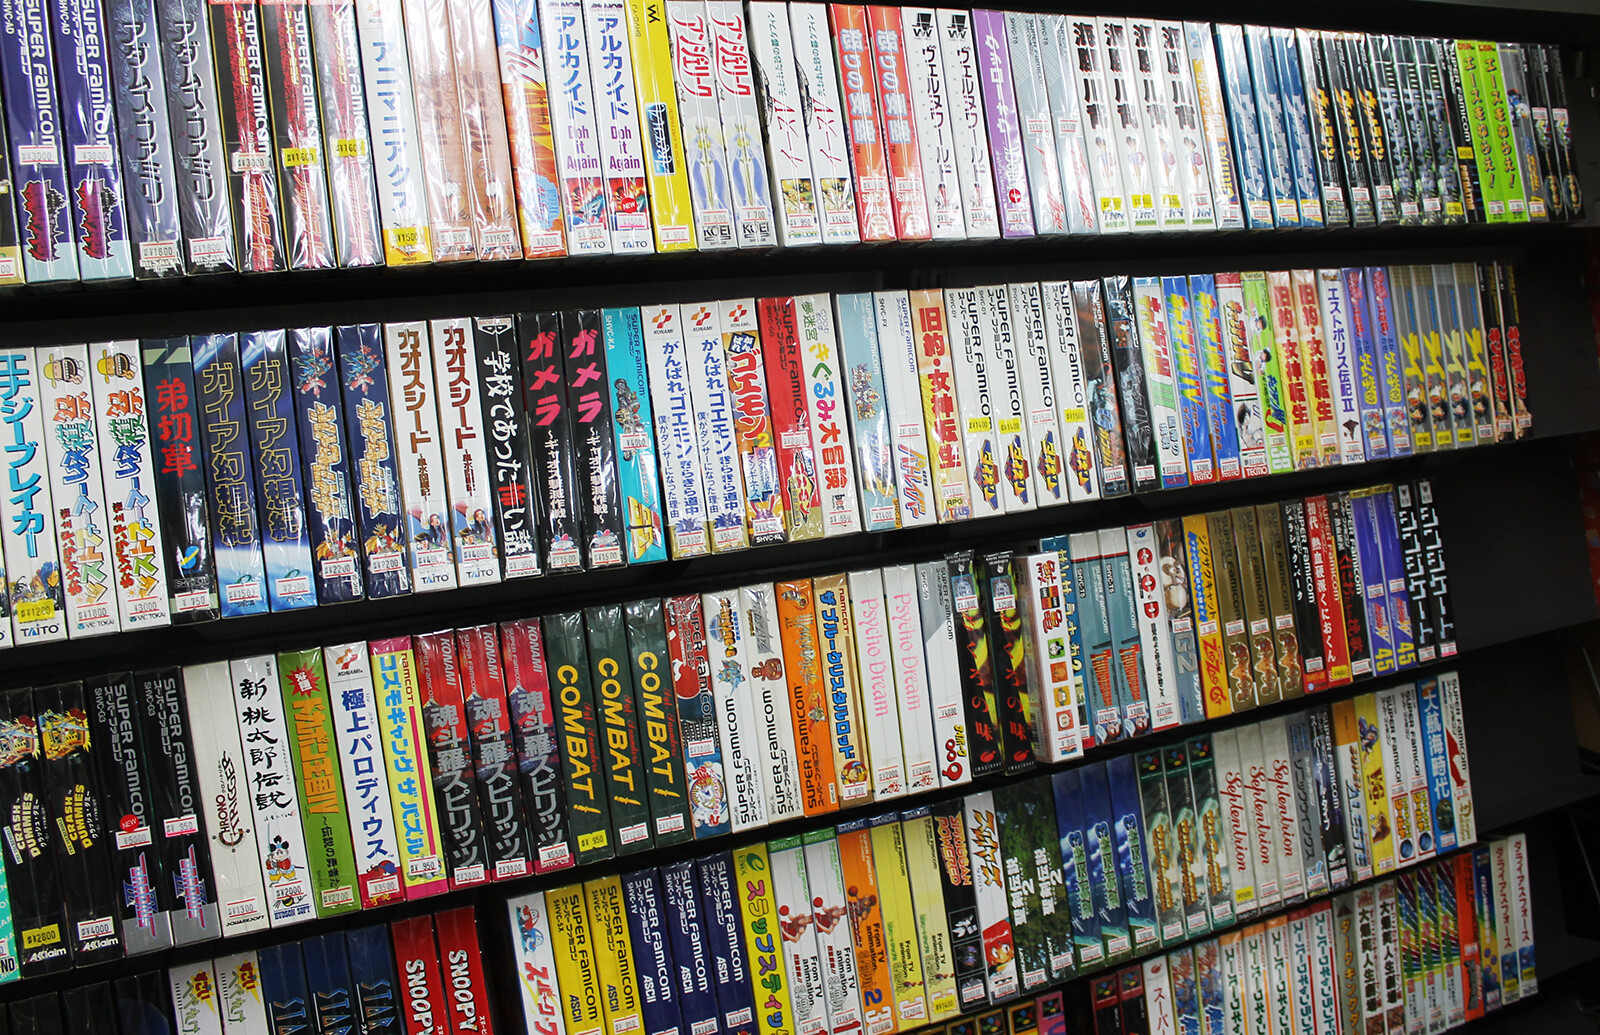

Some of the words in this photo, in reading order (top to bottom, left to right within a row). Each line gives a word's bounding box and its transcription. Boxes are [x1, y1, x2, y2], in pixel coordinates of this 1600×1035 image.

[554, 16, 587, 120] アルカノイド
[598, 17, 630, 120] アルカノイド
[840, 28, 876, 144] 怒りの要塞
[876, 29, 911, 144] 怒りの要塞
[1073, 22, 1101, 130] 海腹川背
[1104, 22, 1139, 130] 海腹川背
[567, 155, 598, 170] Again
[610, 156, 640, 170] Again
[623, 200, 637, 210] NEW
[704, 225, 730, 236] KOEI
[743, 224, 770, 236] KOEI
[605, 314, 615, 350] SHVC-KA
[631, 314, 640, 352] SUPER
[780, 304, 795, 362] SUPER
[900, 297, 910, 325] SUPER
[905, 326, 915, 373] Famicom
[966, 291, 981, 346] SUPER
[995, 289, 1010, 343] SUPER
[1028, 286, 1043, 340] SUPER
[1059, 284, 1073, 337] SUPER
[526, 331, 561, 426] ガメラ
[569, 329, 603, 424] ガメラ
[635, 353, 647, 396] Famicom
[1274, 286, 1309, 425] 旧約・女神転生
[1298, 284, 1334, 422] 旧約・女神転生
[1327, 288, 1354, 413] エストポリス伝記II
[398, 329, 431, 453] カオスシード
[444, 328, 477, 450] カオスシード
[730, 347, 768, 439] ゴエモン
[809, 342, 848, 490] きぐるみ大冒険
[918, 306, 961, 469] 旧約・女神転生
[0, 354, 45, 558] エナジーブレイカー
[156, 379, 198, 478] 弟切草
[202, 362, 252, 546] ガイア幻想紀
[251, 359, 302, 542] ガイア幻想紀
[483, 350, 533, 554] 学校であった怖い話
[662, 341, 691, 459] がんばれゴエモン
[680, 459, 700, 515] きらきら道中
[701, 338, 732, 456] がんばれゴエモン
[720, 455, 740, 511] きらきら道中
[657, 414, 680, 519] 僕がダンサーになった理由
[697, 410, 720, 513] 僕がダンサーになった理由
[1303, 546, 1316, 603] Famicom
[527, 625, 542, 672] KONAMI
[945, 604, 954, 640] Famicom
[440, 638, 456, 686] KONAMI
[483, 631, 499, 679] KONAMI
[902, 655, 921, 711] Dream
[113, 683, 133, 744] SUPER
[163, 677, 183, 738] SUPER
[695, 660, 713, 728] Famicom
[793, 686, 809, 753] Famicom
[870, 661, 889, 718] Dream
[240, 677, 293, 811] 新桃太郎伝説
[725, 698, 743, 765] Famicom
[762, 690, 779, 755] Famicom
[341, 688, 388, 859] 極上パロディウス
[379, 656, 415, 780] コズモギャング
[400, 800, 424, 854] パズル
[431, 703, 479, 868] 魂斗羅スピリッツ
[474, 696, 521, 859] 魂斗羅スピリッツ
[517, 690, 563, 846] 魂斗羅スピリッツ
[803, 758, 819, 810] SUPER
[65, 796, 78, 841] CRASH
[74, 784, 93, 849] DUMMIES
[735, 773, 750, 824] SUPER
[772, 765, 787, 815] SUPER
[872, 814, 897, 826] BANDAI
[12, 804, 26, 850] CRASH
[22, 792, 41, 858] DUMMIES
[122, 817, 138, 829] NEW
[934, 816, 960, 887] POWERED
[950, 811, 973, 886] SPRIGGAN
[592, 890, 602, 922] SHVC-SX
[627, 882, 638, 914] SHVC-TV
[635, 881, 652, 944] スーパーファミコン
[665, 873, 676, 905] SHVC-TV
[672, 872, 690, 935] スーパーファミコン
[701, 865, 712, 897] SHVC-TV
[708, 863, 725, 926] スーパーファミコン
[274, 908, 295, 920] HUDSON
[296, 906, 311, 915] SOFT
[553, 899, 564, 932] SHVC-SX
[561, 897, 577, 962] スーパーファミコン
[600, 888, 615, 951] スーパーファミコン
[642, 878, 659, 927] SUPER
[652, 930, 672, 1001] Famicom
[680, 870, 697, 919] SUPER
[689, 922, 708, 992] Famicom
[716, 861, 733, 909] SUPER
[725, 912, 744, 982] Famicom
[569, 894, 585, 945] SUPER
[578, 950, 597, 1019] Famicom
[607, 885, 623, 935] SUPER
[616, 940, 635, 1009] Famicom
[716, 955, 729, 984] ASCII
[809, 956, 818, 981] From
[815, 982, 823, 998] TV
[836, 950, 849, 997] animation
[843, 947, 851, 969] From
[866, 925, 878, 971] animation
[899, 942, 908, 978] animation
[932, 935, 941, 970] animation
[449, 949, 478, 1032] SNOOPY
[569, 995, 582, 1022] ASCII
[606, 984, 619, 1012] ASCII
[643, 974, 657, 1003] ASCII
[679, 965, 693, 993] ASCII
[802, 958, 814, 1006] animation
